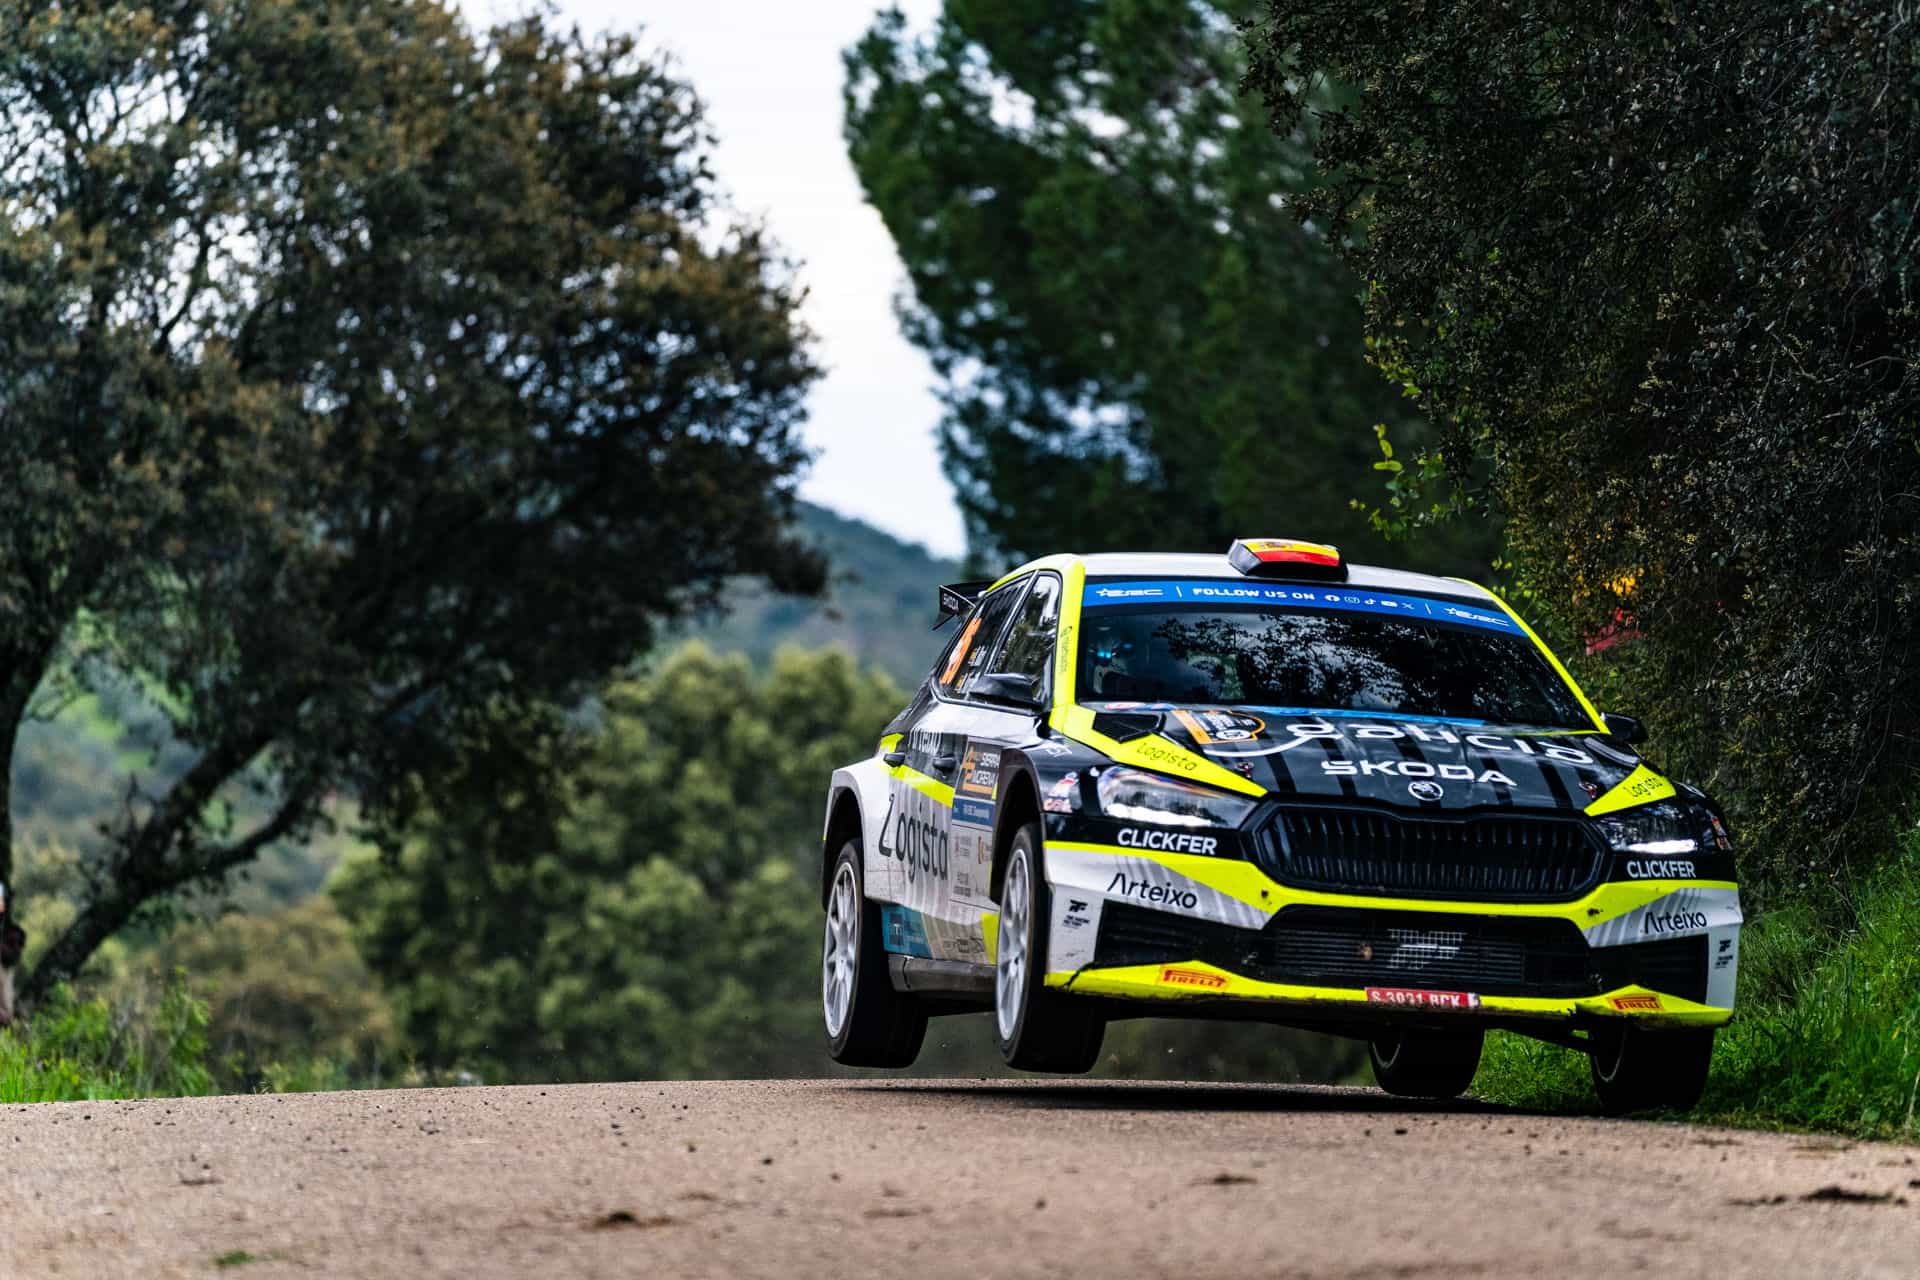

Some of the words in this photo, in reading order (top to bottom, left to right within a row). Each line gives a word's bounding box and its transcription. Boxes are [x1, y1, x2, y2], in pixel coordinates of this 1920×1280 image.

[1193, 588, 1259, 598] FOLLOW
[1265, 591, 1287, 599] US
[1292, 592, 1315, 601] ON
[1117, 828, 1218, 855] CLICKFER
[1627, 860, 1697, 879] CLICKFER
[1106, 872, 1198, 909] Arteixo
[1642, 906, 1708, 934] Arteixo
[1163, 969, 1227, 989] PIRELLI
[1614, 996, 1661, 1010] PIRELLI
